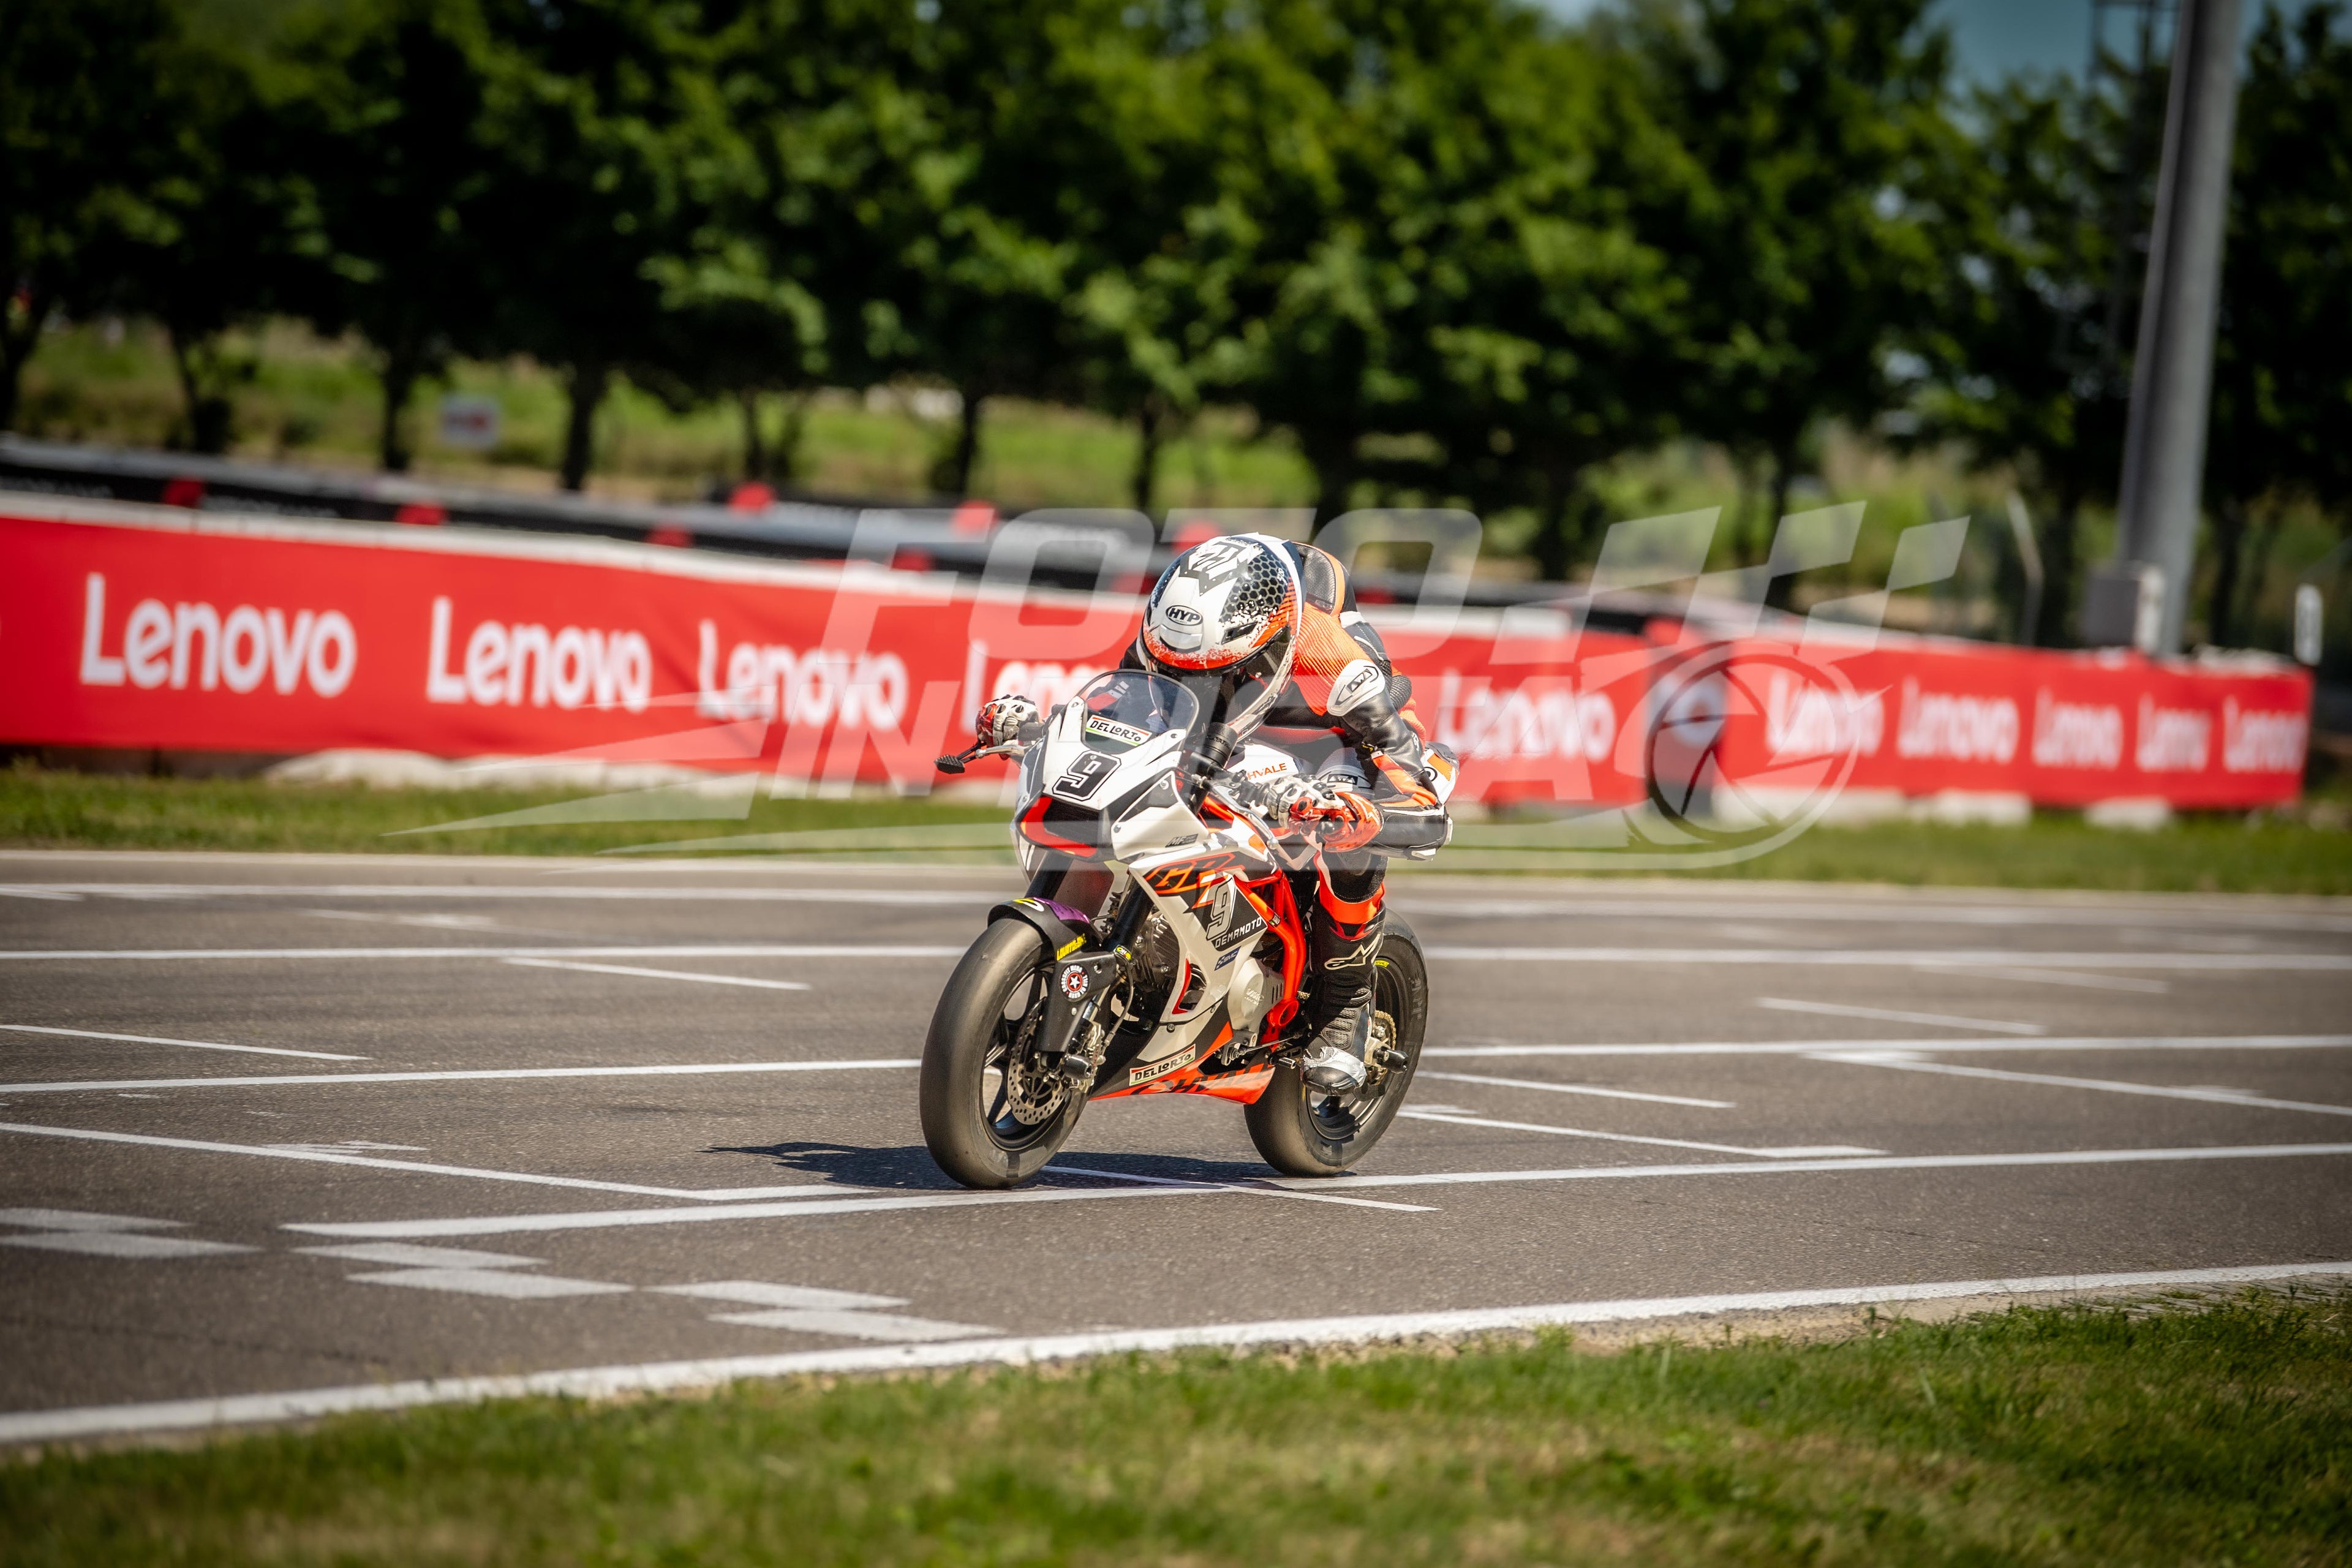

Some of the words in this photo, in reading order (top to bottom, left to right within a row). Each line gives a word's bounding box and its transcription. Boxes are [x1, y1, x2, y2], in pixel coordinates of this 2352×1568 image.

[80, 572, 358, 698] Lenovo
[1167, 607, 1201, 621] HYP
[427, 597, 652, 712] Lenovo
[696, 618, 908, 731] Lenovo
[1089, 720, 1142, 742] DELLORTO
[1434, 667, 1616, 763] Lenovo
[1896, 676, 2020, 765] Lenovo
[1052, 750, 1121, 802] 9
[1247, 763, 1287, 780] HVALE
[1206, 876, 1236, 941] 9
[1215, 917, 1262, 949] DEMAMOTO
[1135, 1053, 1191, 1082] DELLORTO
